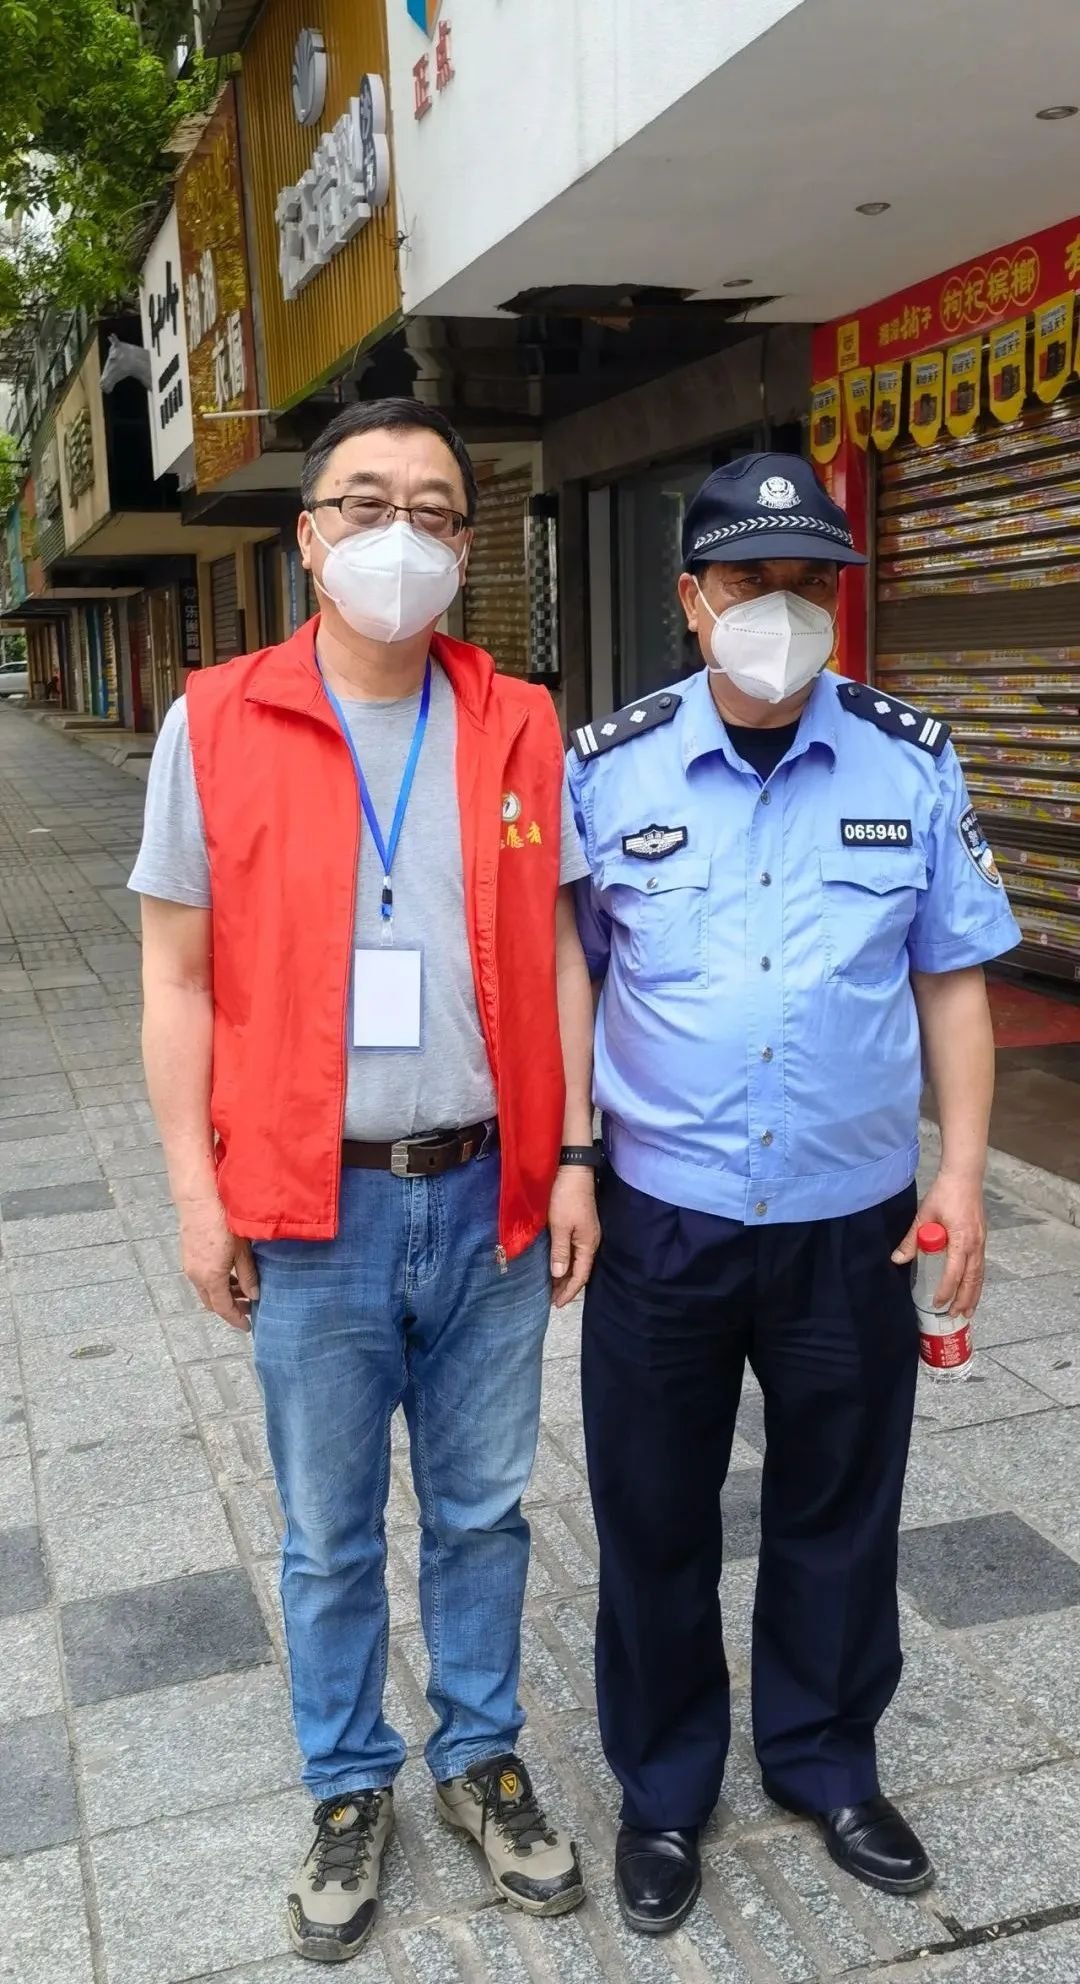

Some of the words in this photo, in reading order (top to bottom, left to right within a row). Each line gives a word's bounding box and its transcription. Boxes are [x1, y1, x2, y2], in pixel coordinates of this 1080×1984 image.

[943, 257, 1036, 322] 枸杞槟榔
[500, 821, 542, 849] 愿者
[844, 824, 907, 840] 065940
